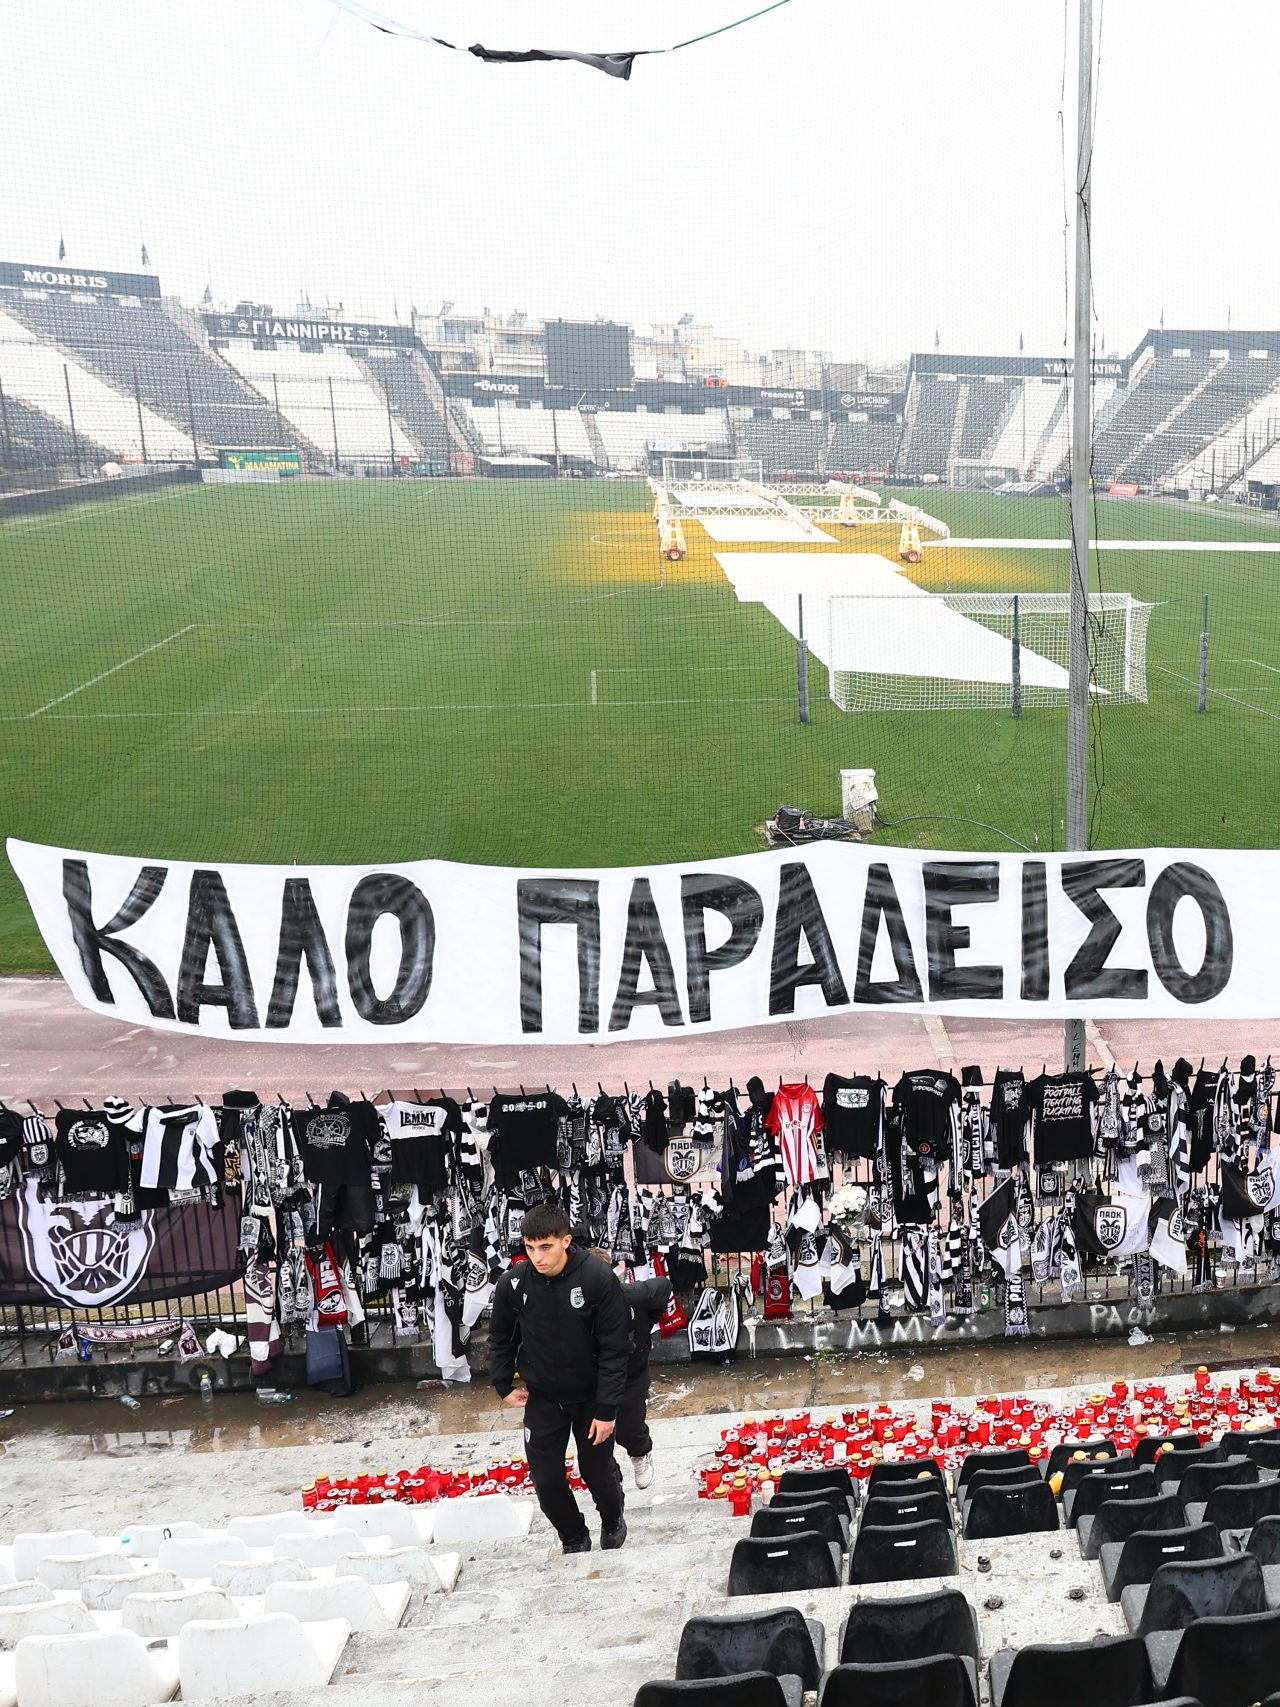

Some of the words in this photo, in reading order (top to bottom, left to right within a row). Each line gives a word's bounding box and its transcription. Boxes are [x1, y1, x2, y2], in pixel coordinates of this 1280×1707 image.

[22, 270, 108, 289] MORRIS
[252, 320, 354, 341] ΓΙΑΝΝΙΡΗΣ
[62, 858, 436, 1028] ΚΑΛΟ
[517, 858, 1235, 1034] ΠΑΡΑΔΕΙΣΟ
[400, 1111, 436, 1127] LEMMY
[1099, 1211, 1122, 1219] ΠΑΟΚ
